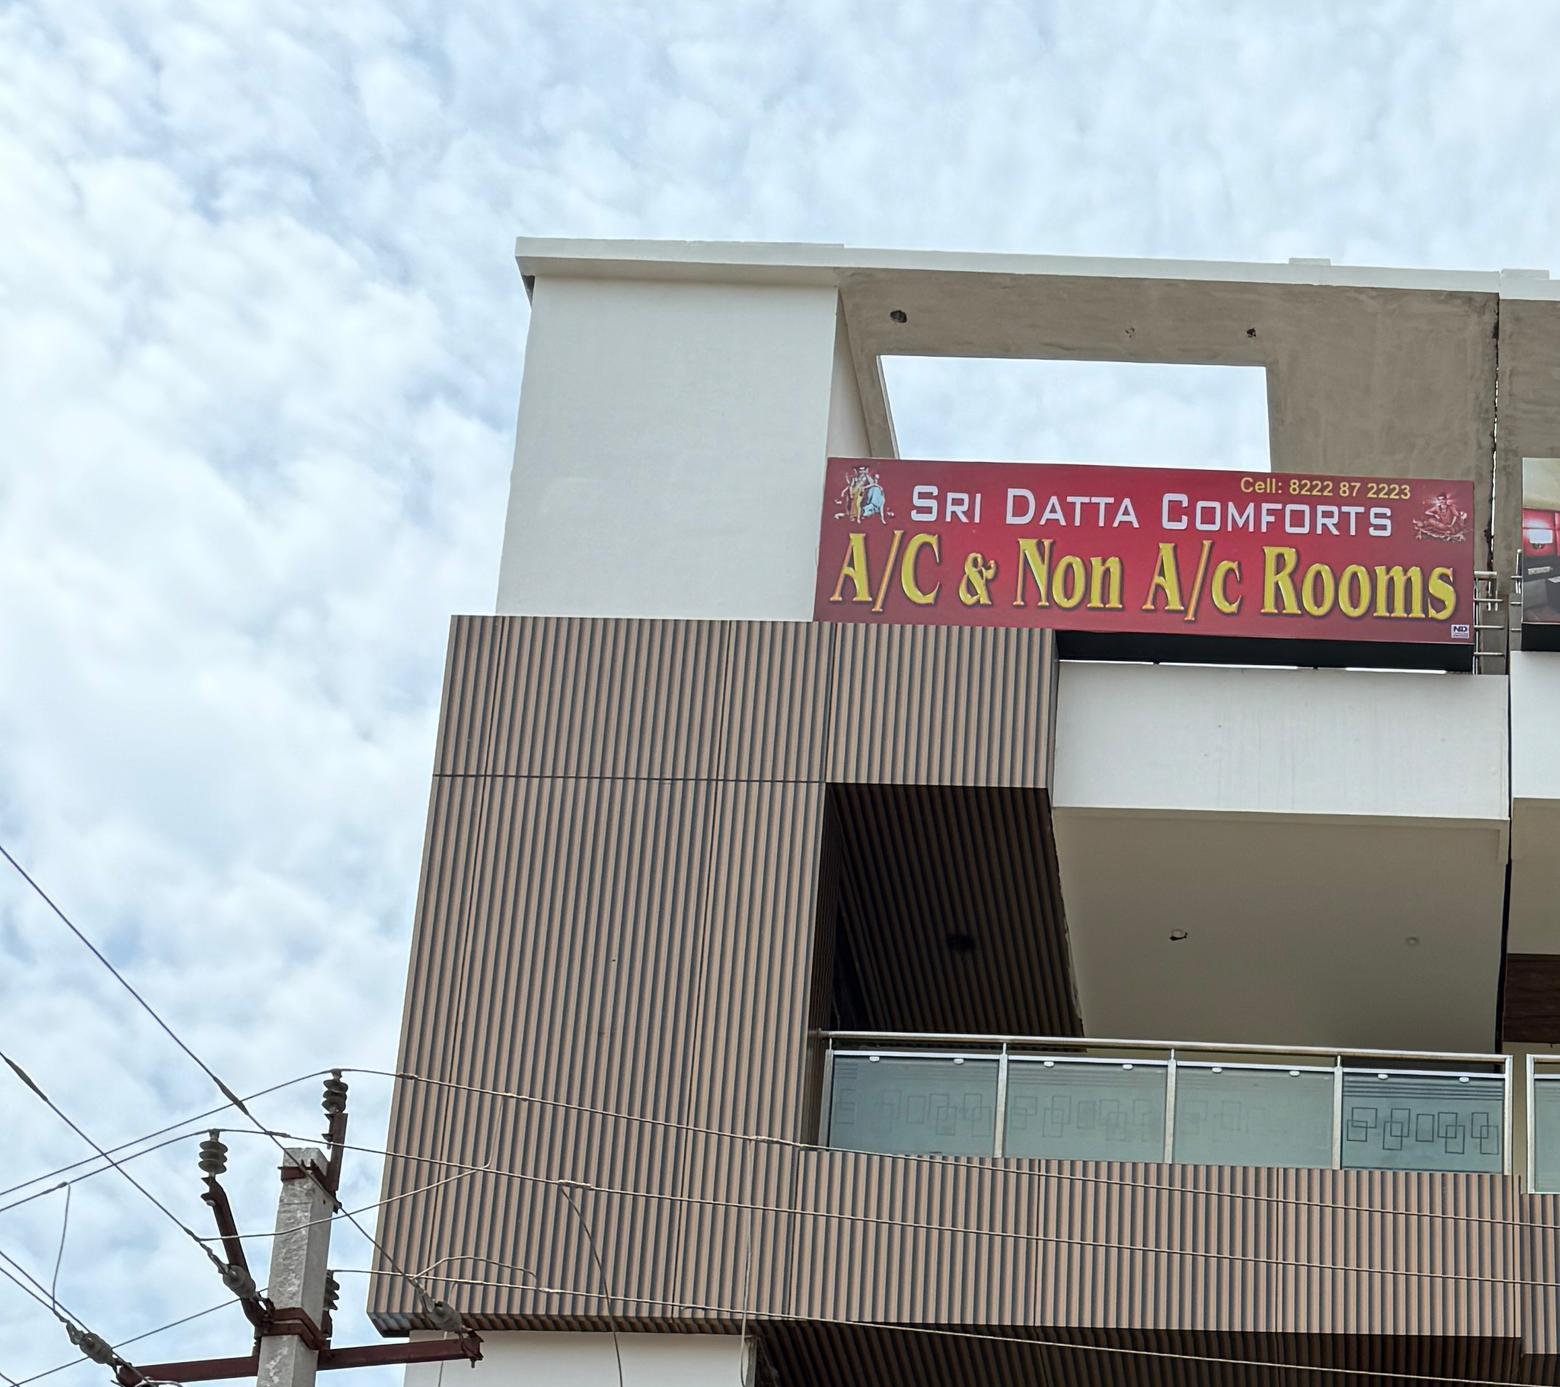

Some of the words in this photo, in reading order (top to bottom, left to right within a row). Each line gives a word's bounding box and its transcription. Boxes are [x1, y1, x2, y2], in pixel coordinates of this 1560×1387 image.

[1240, 476, 1281, 495] Cell:
[1288, 479, 1335, 497] 8222
[1339, 481, 1363, 498] 87
[1366, 482, 1411, 500] 2223
[829, 530, 941, 612] A/C
[958, 552, 998, 606] &
[1012, 538, 1123, 609] Non
[1142, 539, 1242, 621] A/c
[1259, 545, 1457, 621] Rooms
